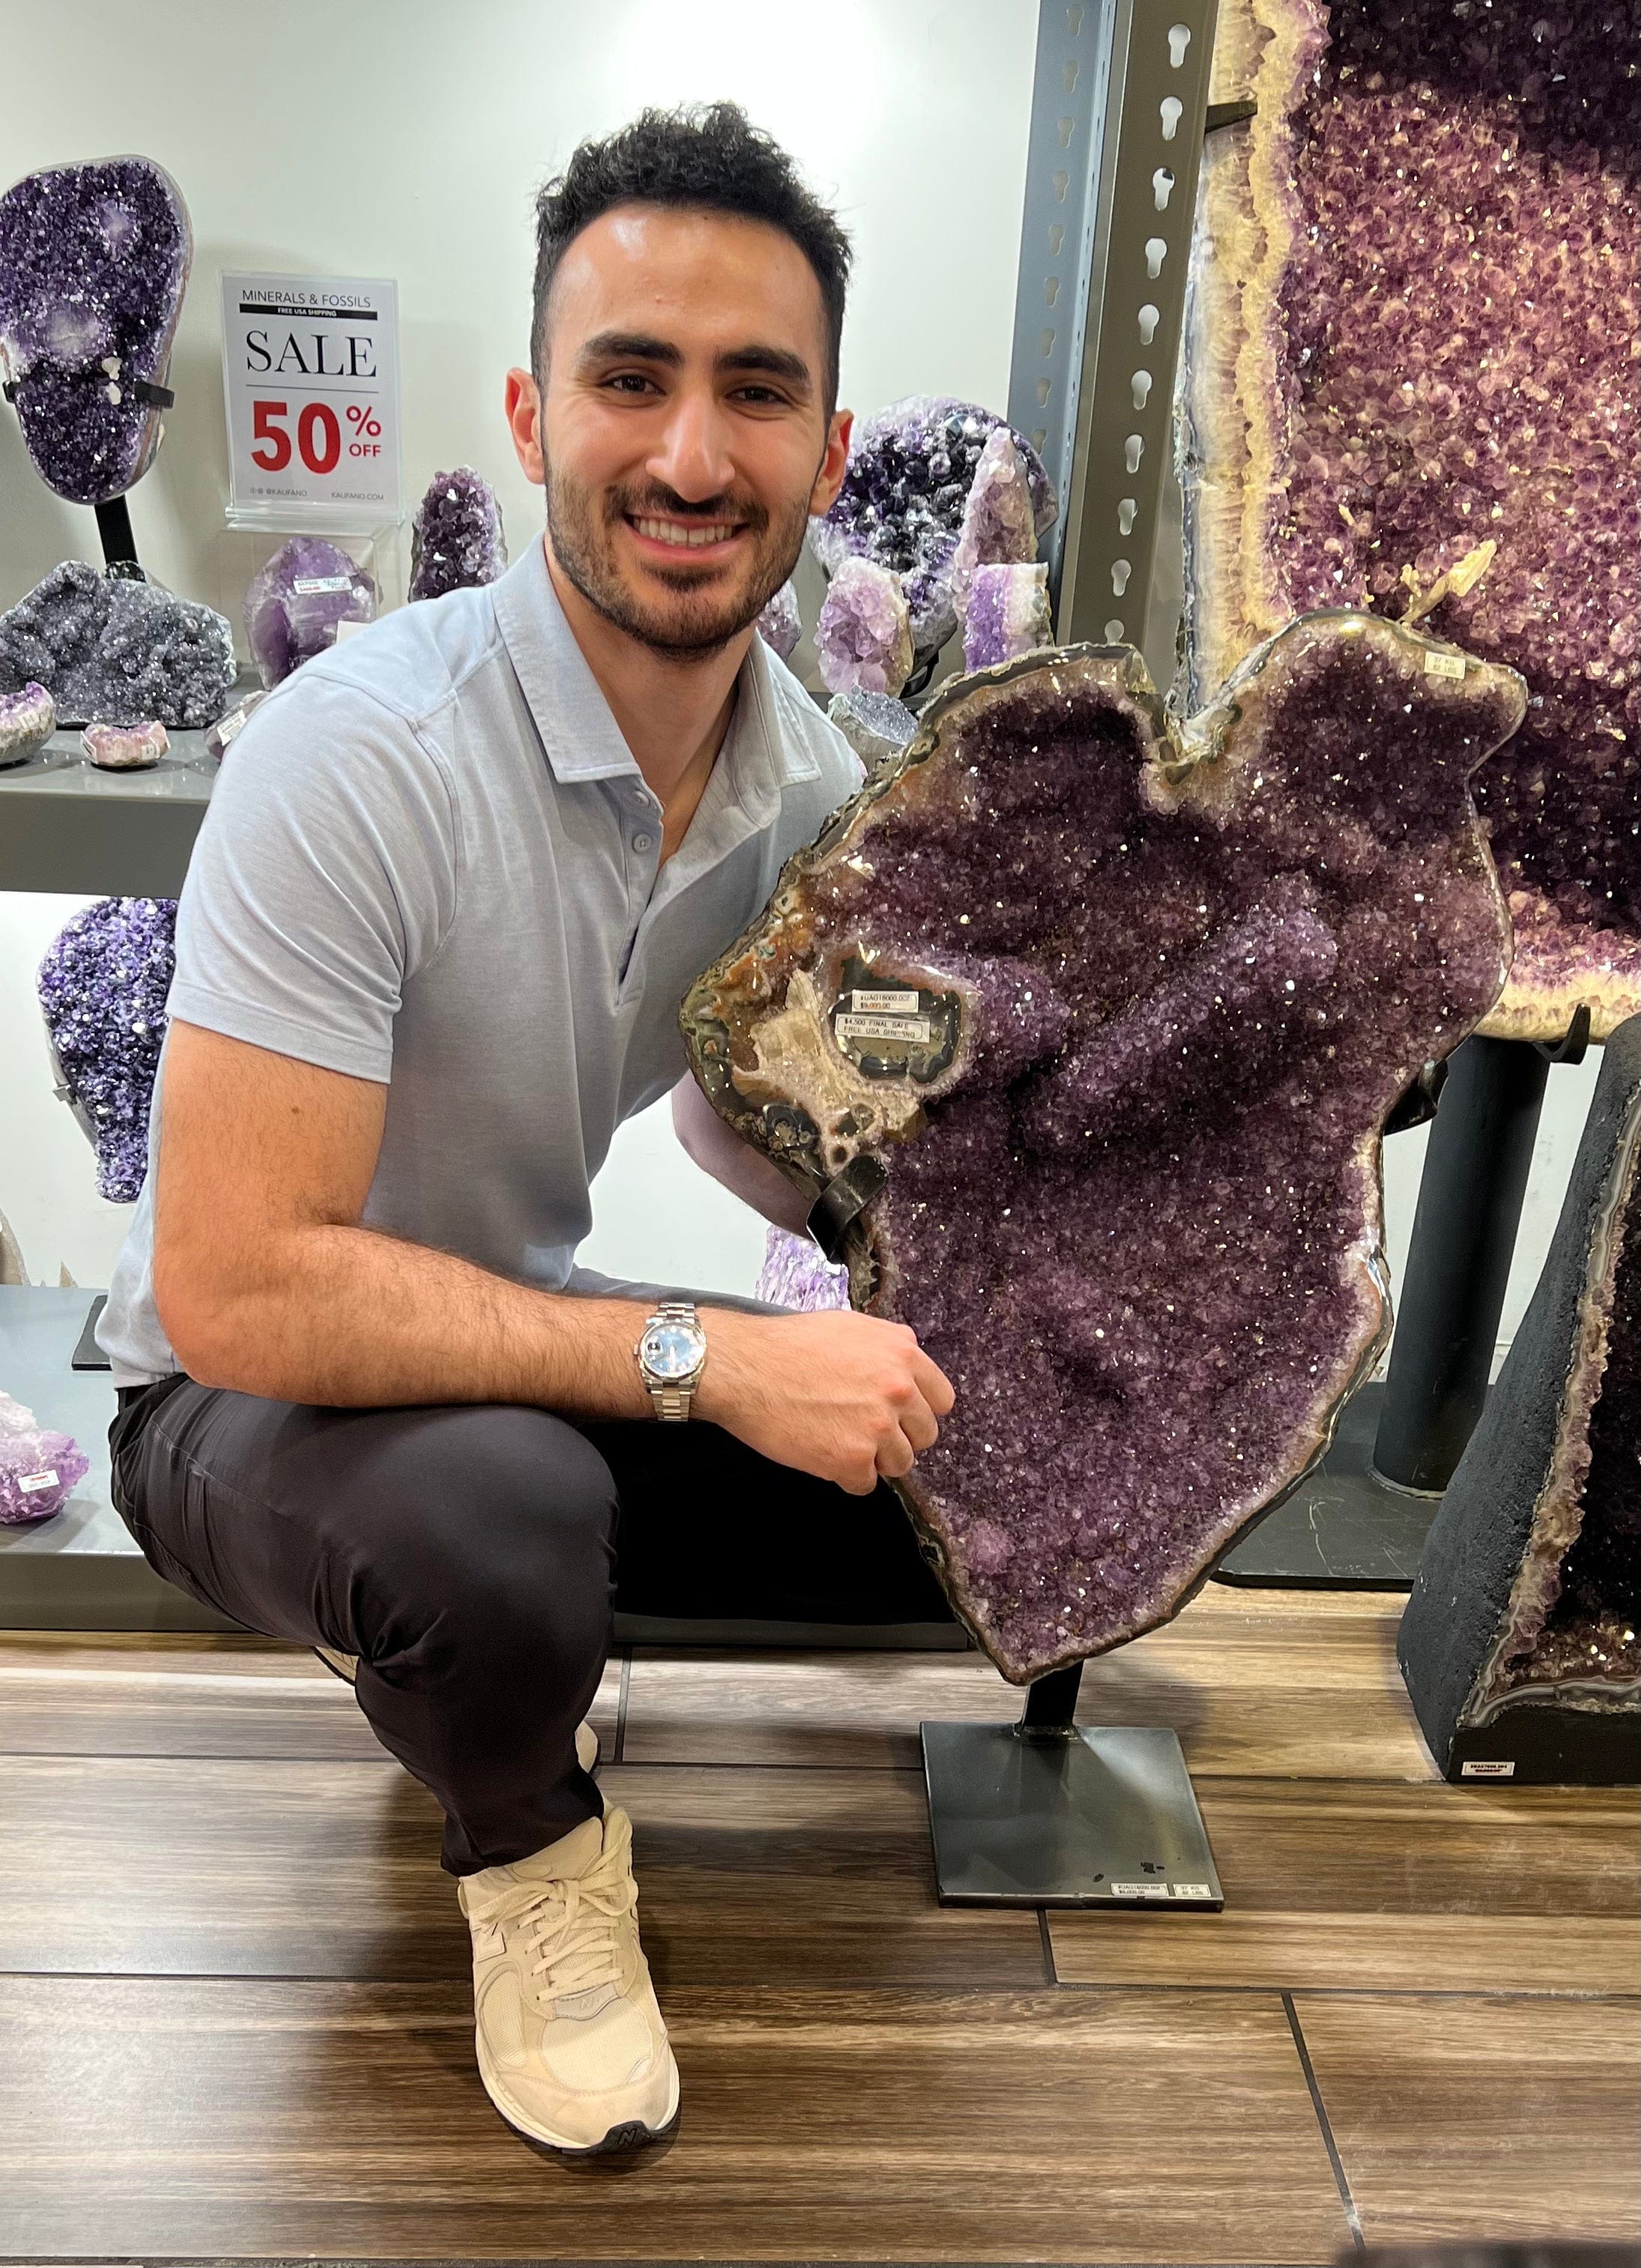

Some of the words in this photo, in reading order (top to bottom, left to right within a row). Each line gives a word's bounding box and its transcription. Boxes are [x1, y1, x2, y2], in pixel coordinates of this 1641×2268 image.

[243, 289, 306, 305] MINERALS
[309, 293, 318, 305] &
[322, 294, 371, 309] FOSSILS
[308, 309, 337, 317] SHIPPING
[246, 329, 377, 377] SALE
[348, 443, 382, 457] OFF
[331, 491, 385, 501] KALIFANO.COM
[869, 1019, 888, 1028] FINAL
